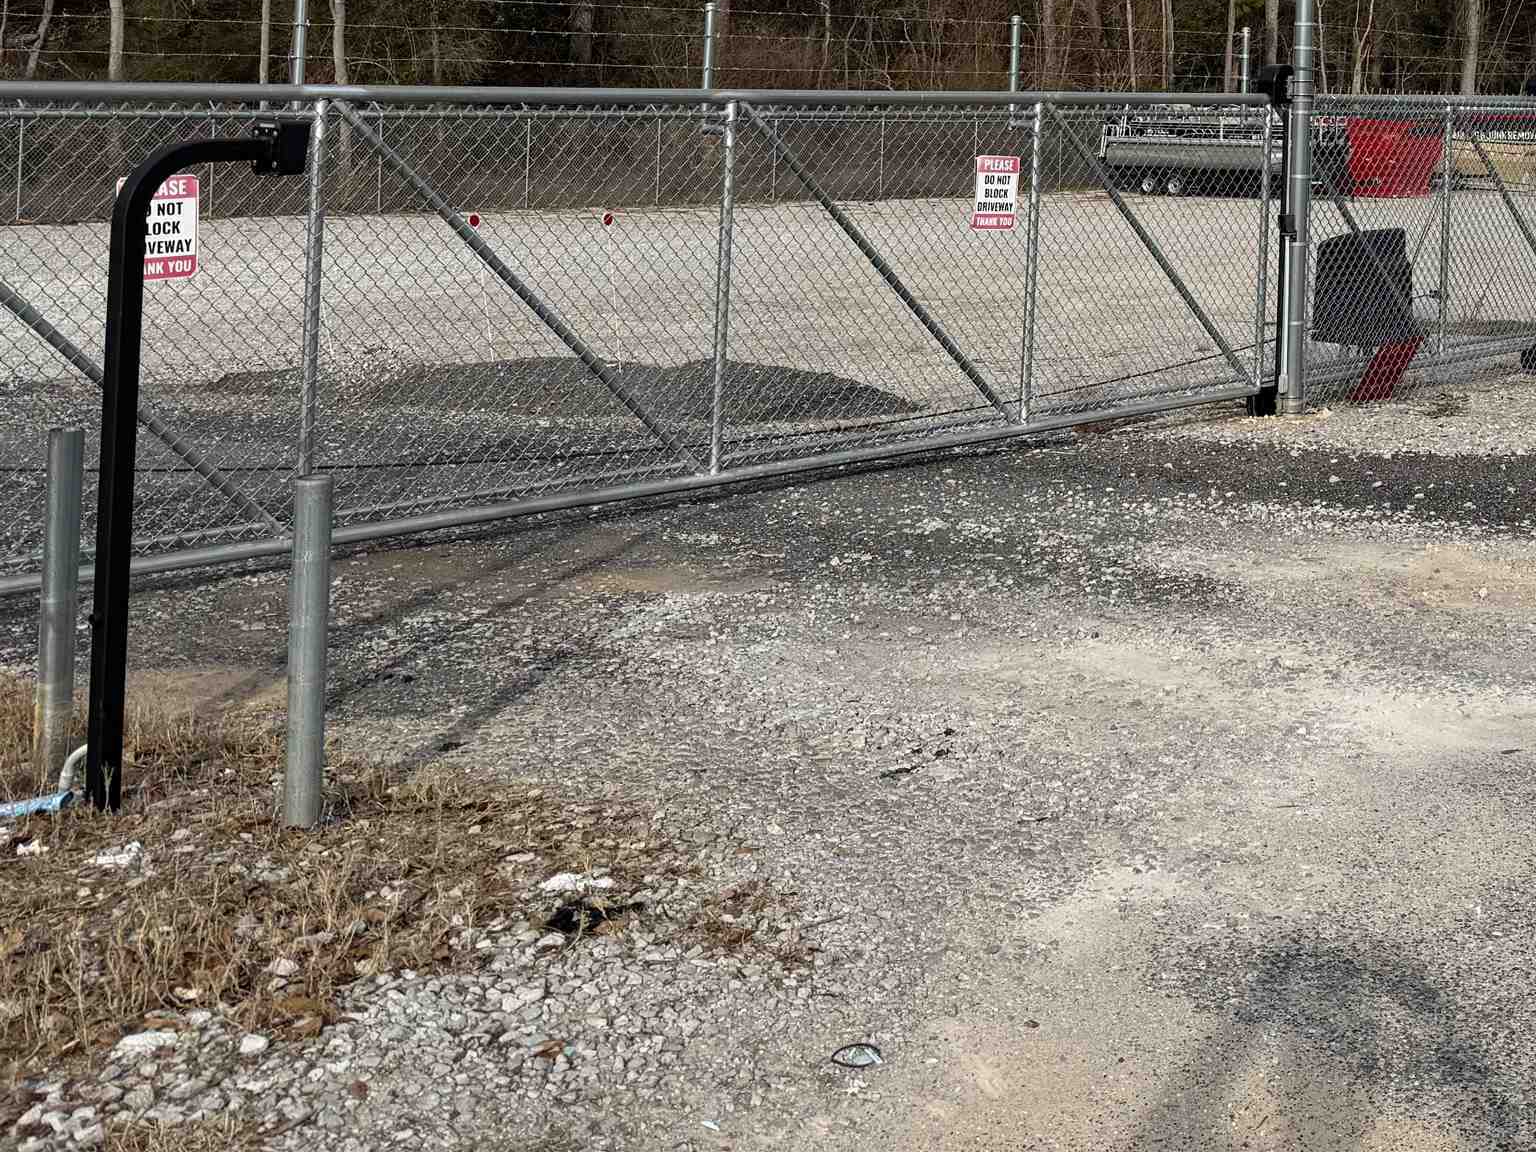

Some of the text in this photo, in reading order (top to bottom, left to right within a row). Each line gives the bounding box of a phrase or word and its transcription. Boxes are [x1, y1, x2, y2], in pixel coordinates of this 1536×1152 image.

[984, 160, 1014, 171] PLEASE
[985, 175, 1011, 185] DO NOT
[156, 179, 187, 196] ASE
[984, 189, 1008, 198] BLOCK
[157, 202, 183, 216] NOT
[977, 202, 1013, 212] DRIVEWAY
[976, 217, 1012, 226] THANK YOU
[145, 221, 180, 236] LOCK
[147, 239, 192, 255] VEWAY
[168, 260, 192, 273] YOU
